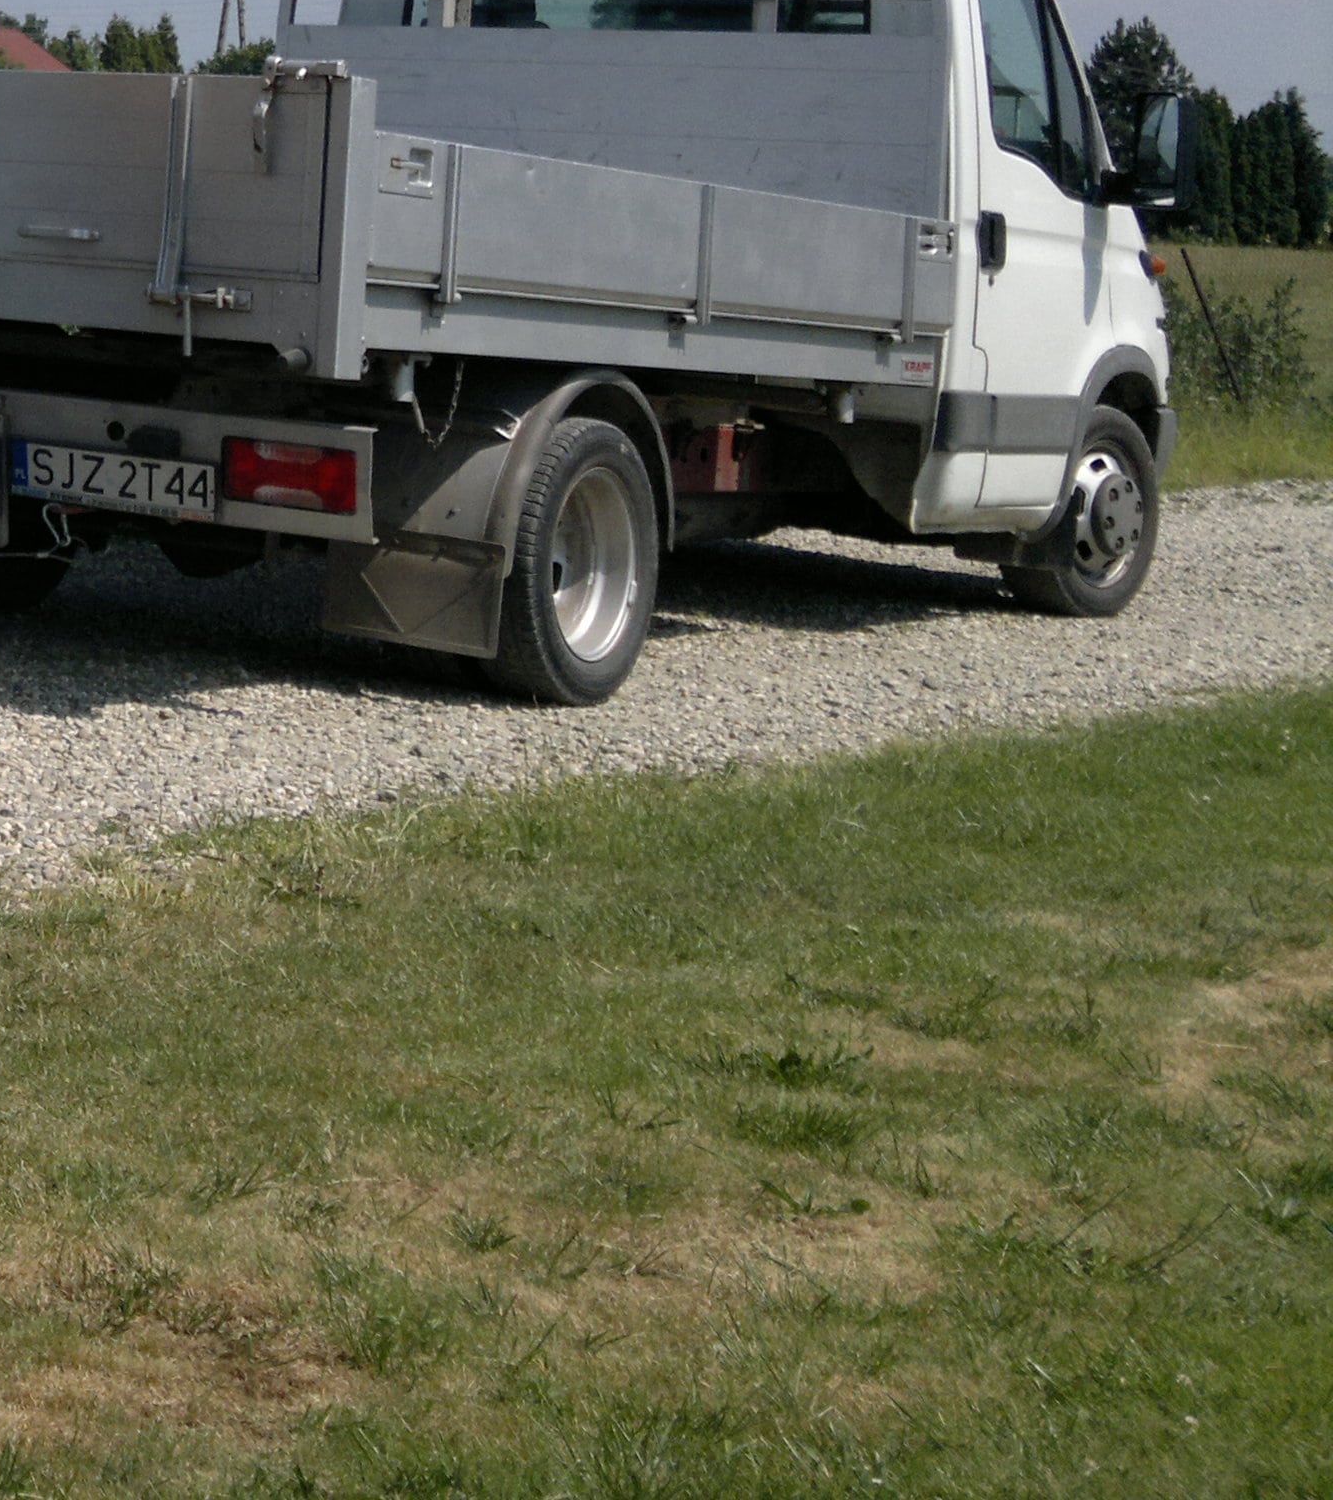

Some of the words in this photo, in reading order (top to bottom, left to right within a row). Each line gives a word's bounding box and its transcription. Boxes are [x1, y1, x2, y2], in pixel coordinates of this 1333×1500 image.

[14, 468, 27, 480] PL
[33, 448, 105, 495] SJZ
[118, 460, 209, 508] 2T44
